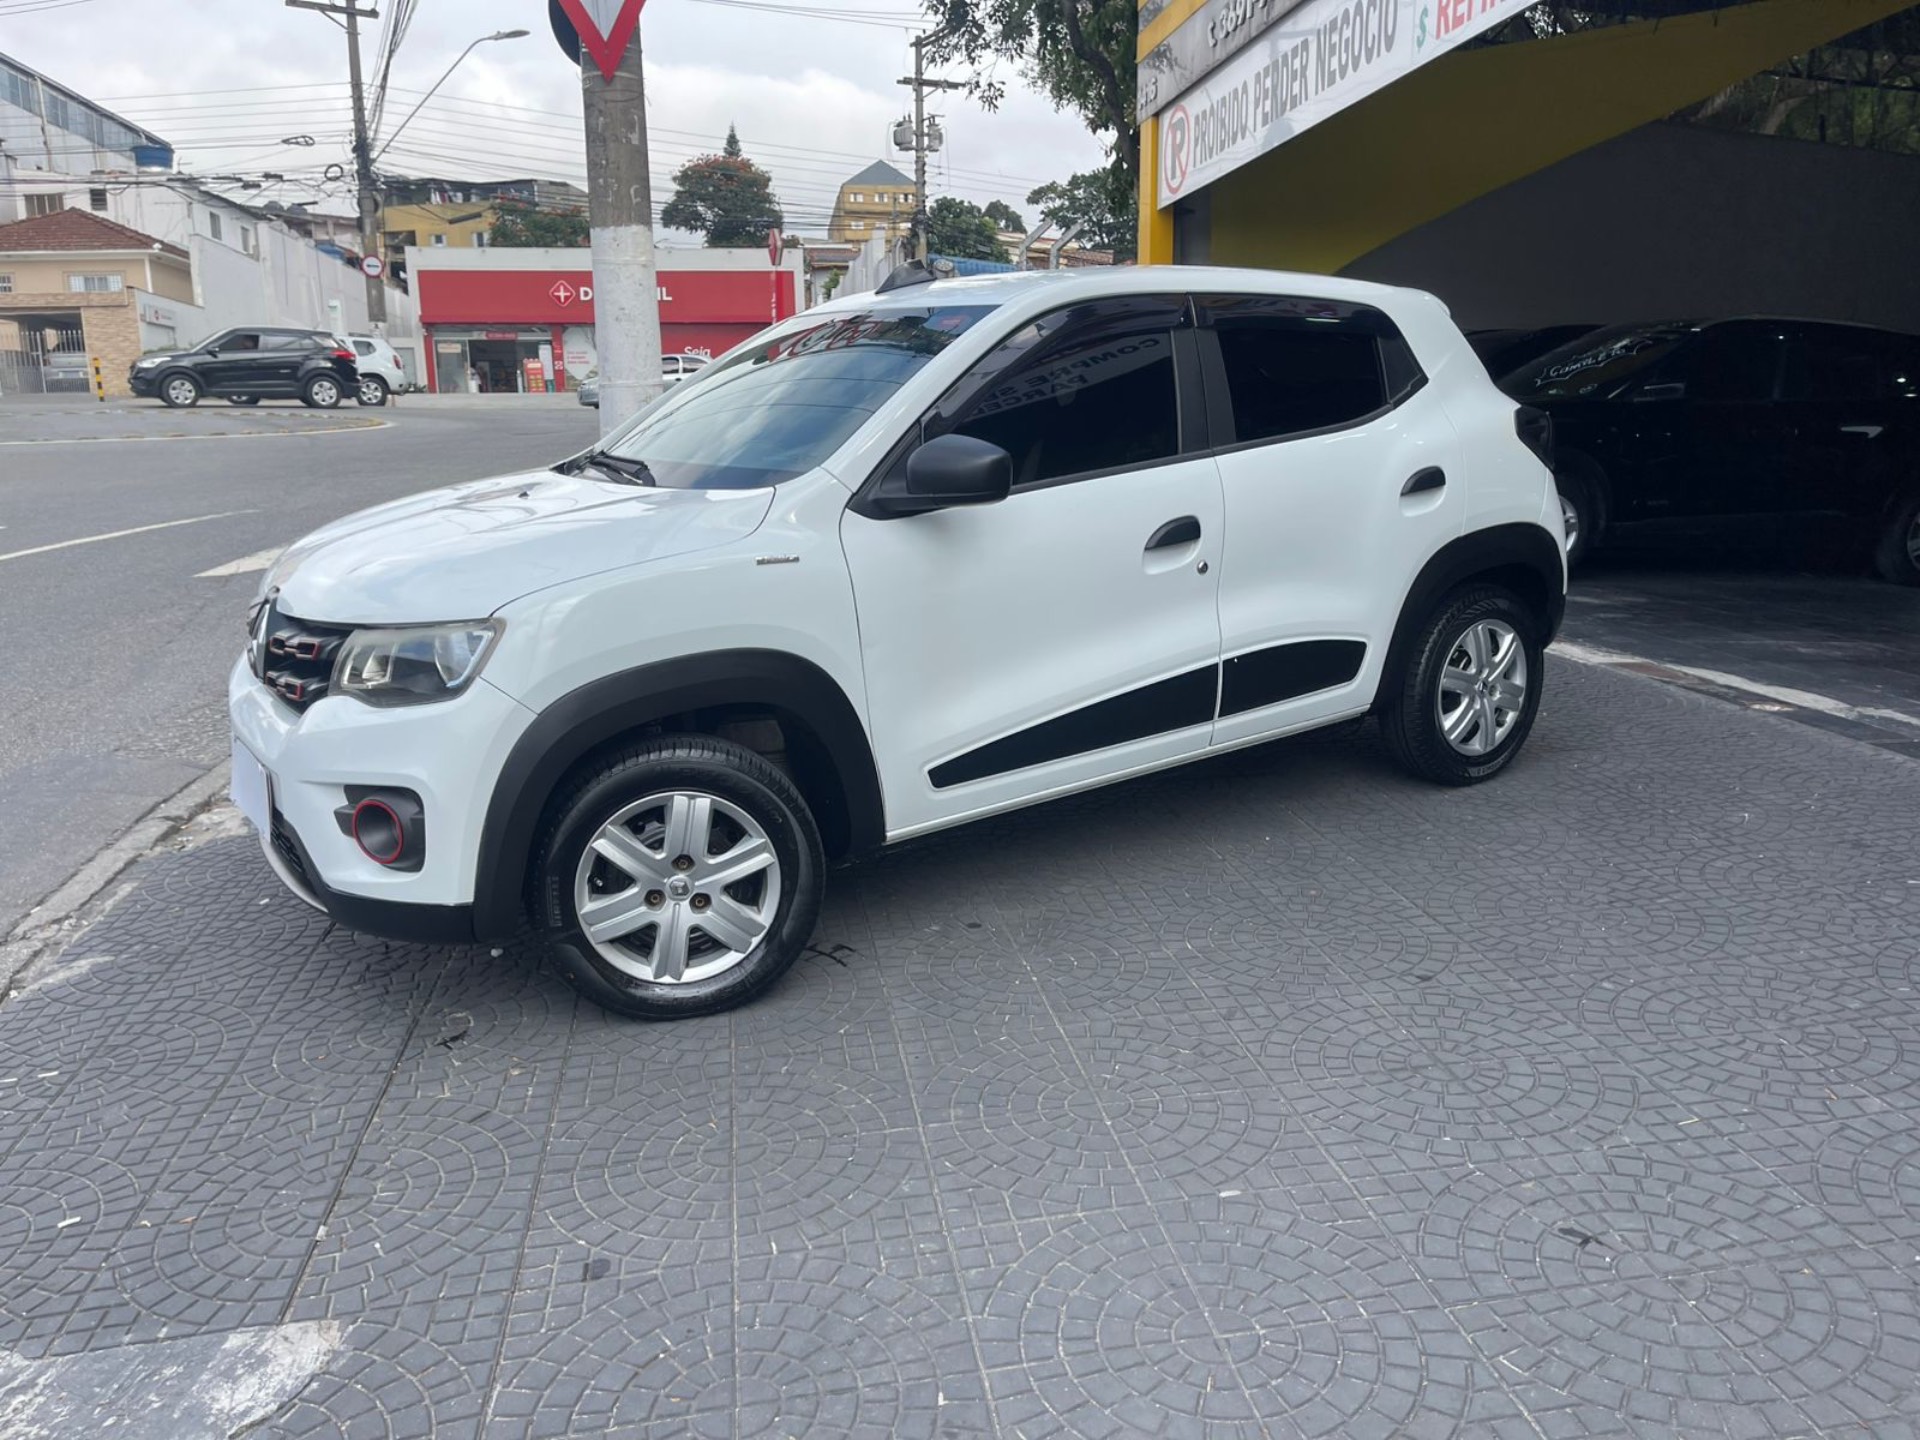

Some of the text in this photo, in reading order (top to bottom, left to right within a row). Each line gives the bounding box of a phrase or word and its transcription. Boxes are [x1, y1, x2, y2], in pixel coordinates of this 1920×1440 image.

[1193, 80, 1249, 169] PROIBIDO
[1253, 37, 1310, 133] PERDER
[1314, 0, 1398, 97] NEGOCIO
